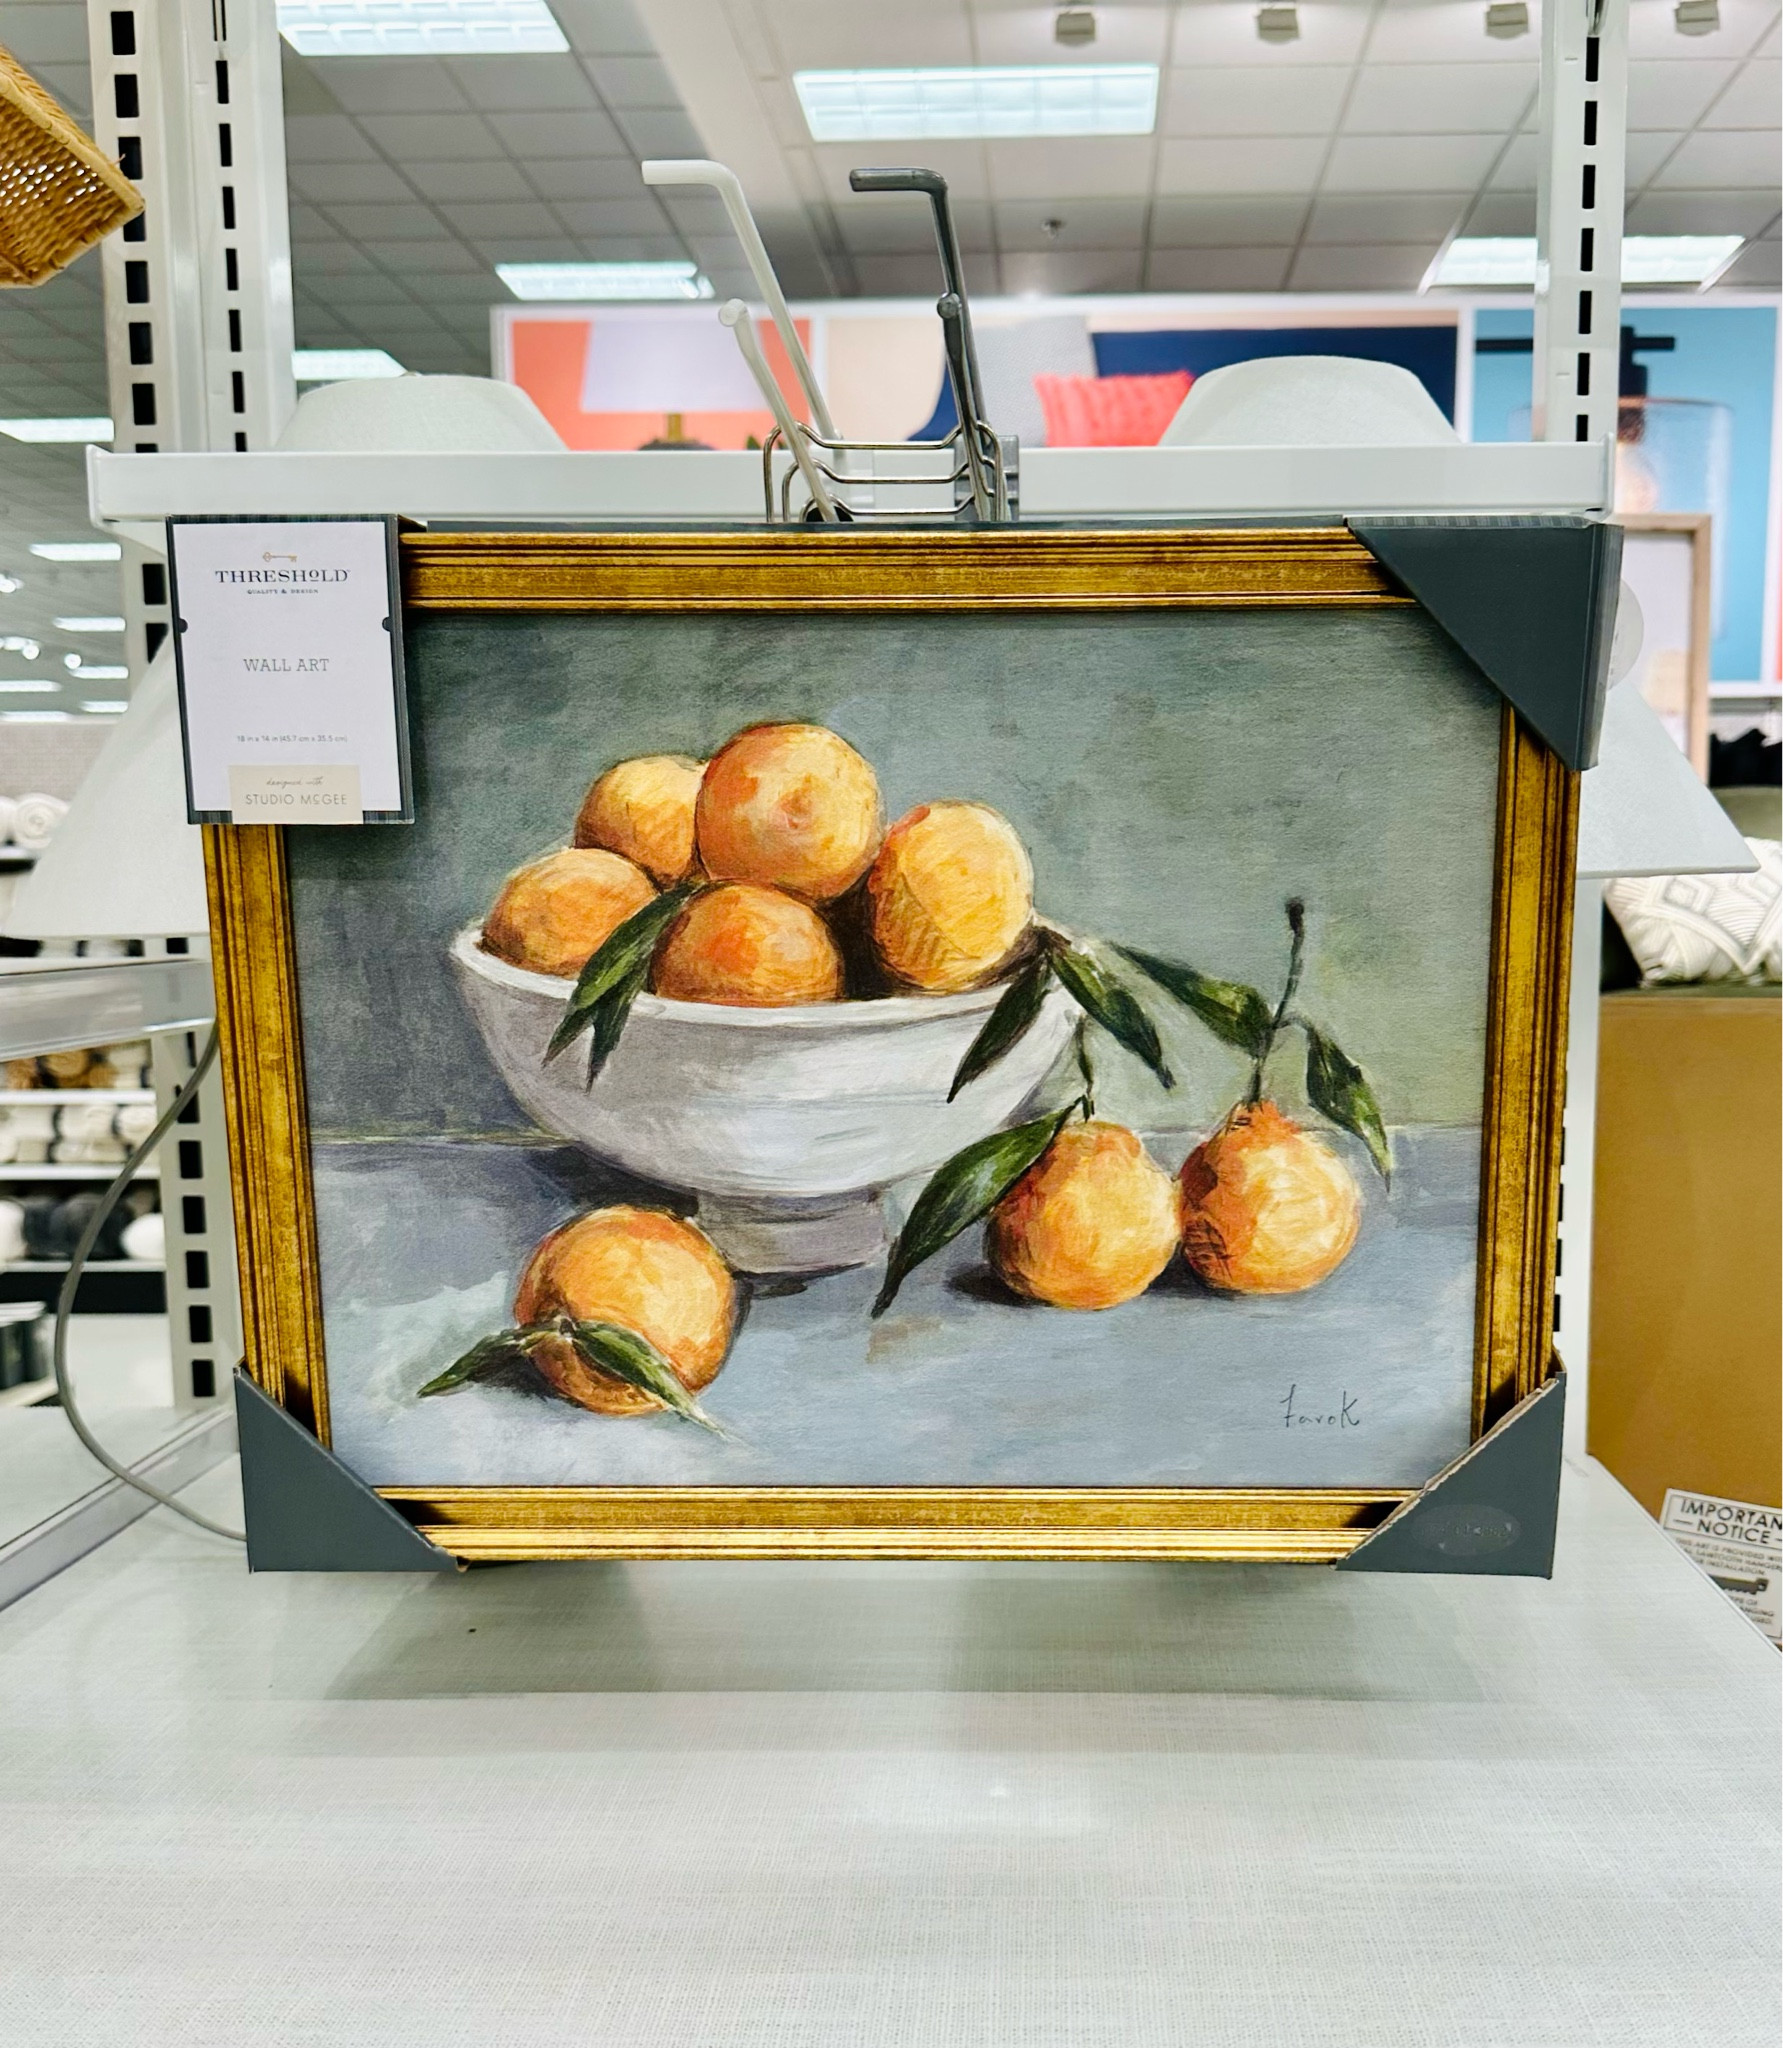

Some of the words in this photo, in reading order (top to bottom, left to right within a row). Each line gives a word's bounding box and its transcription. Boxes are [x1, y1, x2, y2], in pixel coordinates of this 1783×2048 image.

[214, 569, 349, 583] THRESHOLD
[243, 658, 292, 672] WALL
[296, 658, 330, 671] ART
[245, 793, 295, 805] STUDIO
[1680, 1499, 1782, 1531] IMPORTAN
[1697, 1519, 1771, 1544] NOTICE
